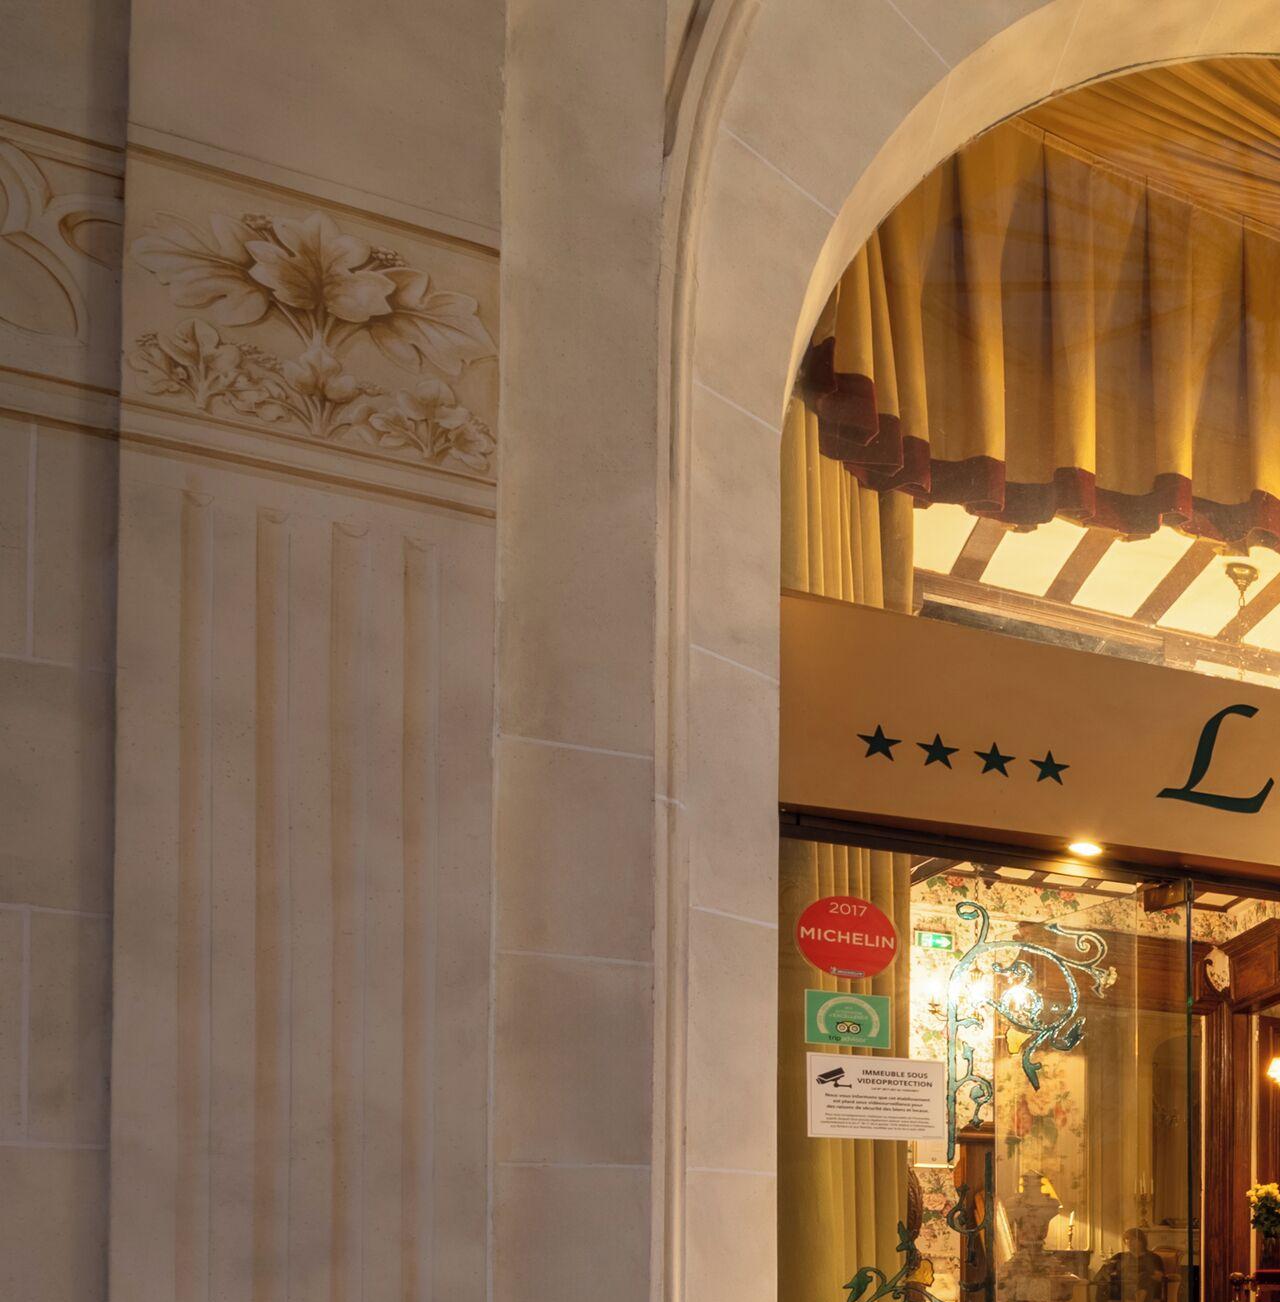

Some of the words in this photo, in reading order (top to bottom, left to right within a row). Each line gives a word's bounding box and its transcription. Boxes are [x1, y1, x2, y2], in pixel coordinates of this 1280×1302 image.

[829, 902, 867, 917] 2017
[800, 926, 895, 949] MICHELIN
[862, 1069, 904, 1078] IMMEUBLE
[857, 1078, 933, 1088] VIDEOPROTECTION
